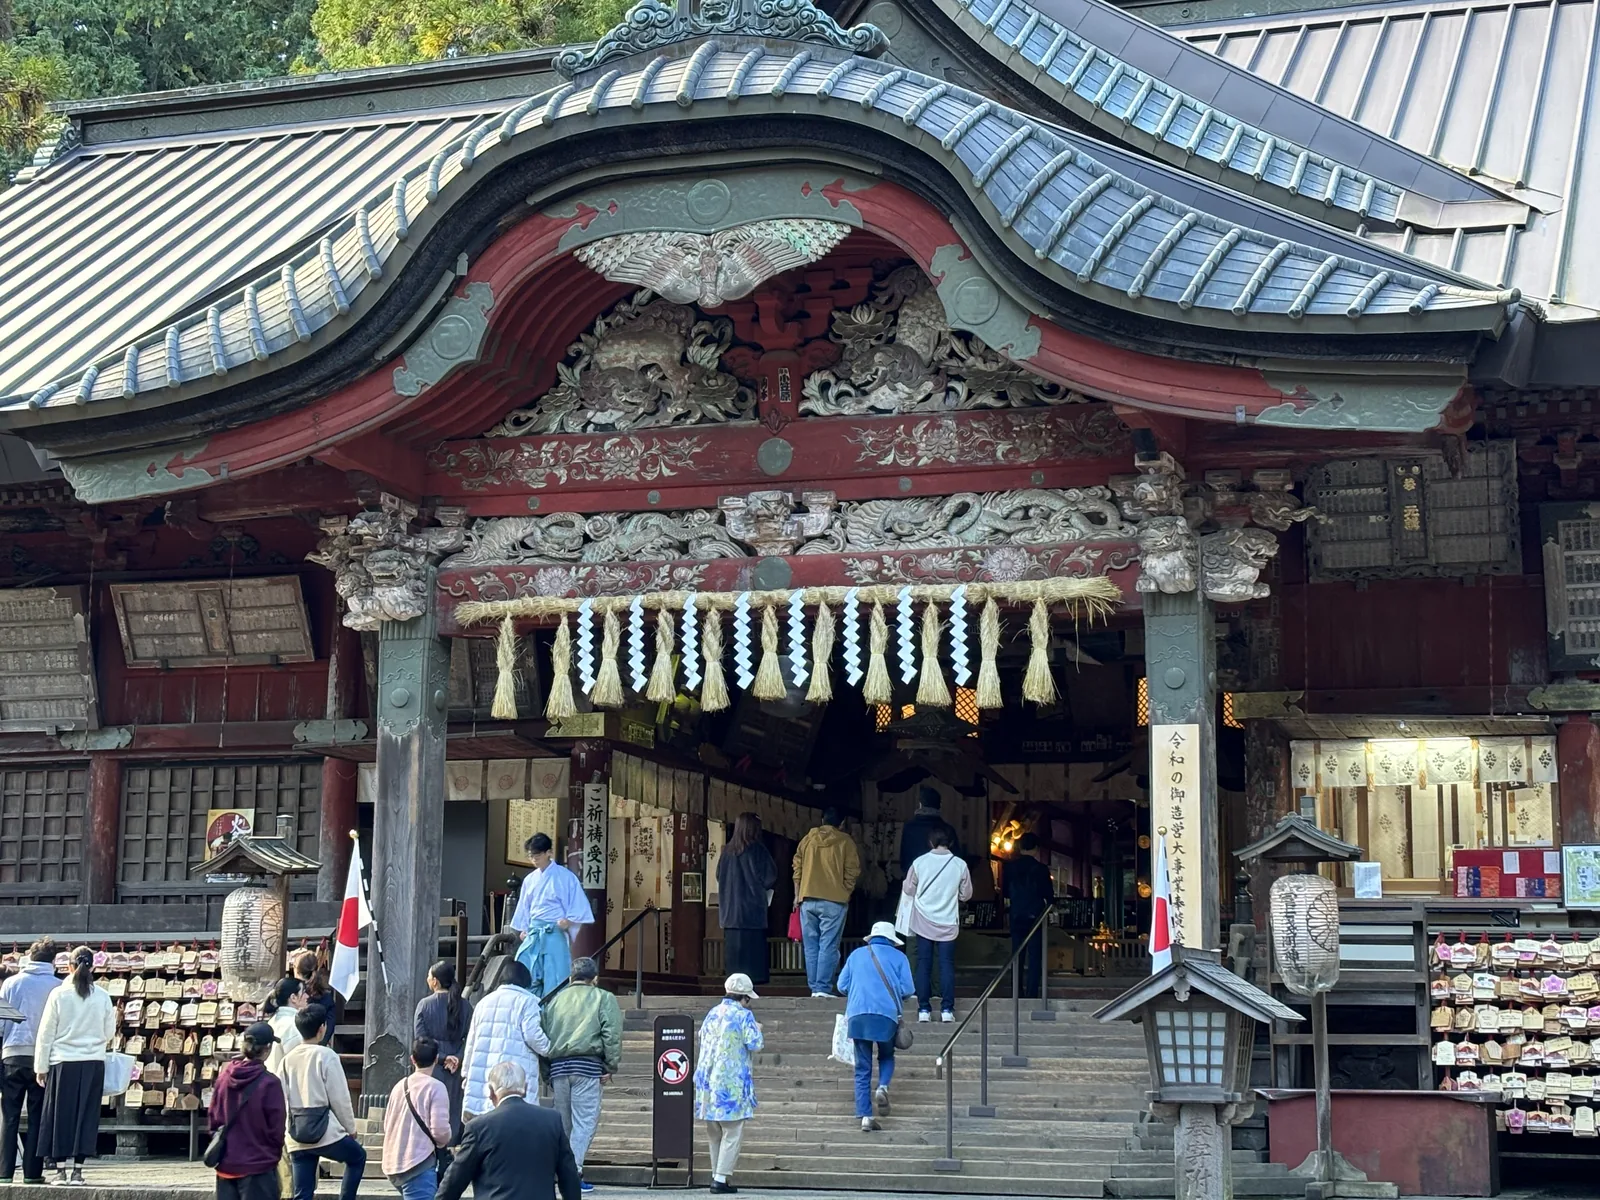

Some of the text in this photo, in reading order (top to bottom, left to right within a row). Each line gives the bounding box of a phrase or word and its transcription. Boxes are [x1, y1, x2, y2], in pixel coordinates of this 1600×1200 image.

[585, 787, 604, 884] ご祈祷受付
[1184, 1116, 1212, 1199] 奉寄附
